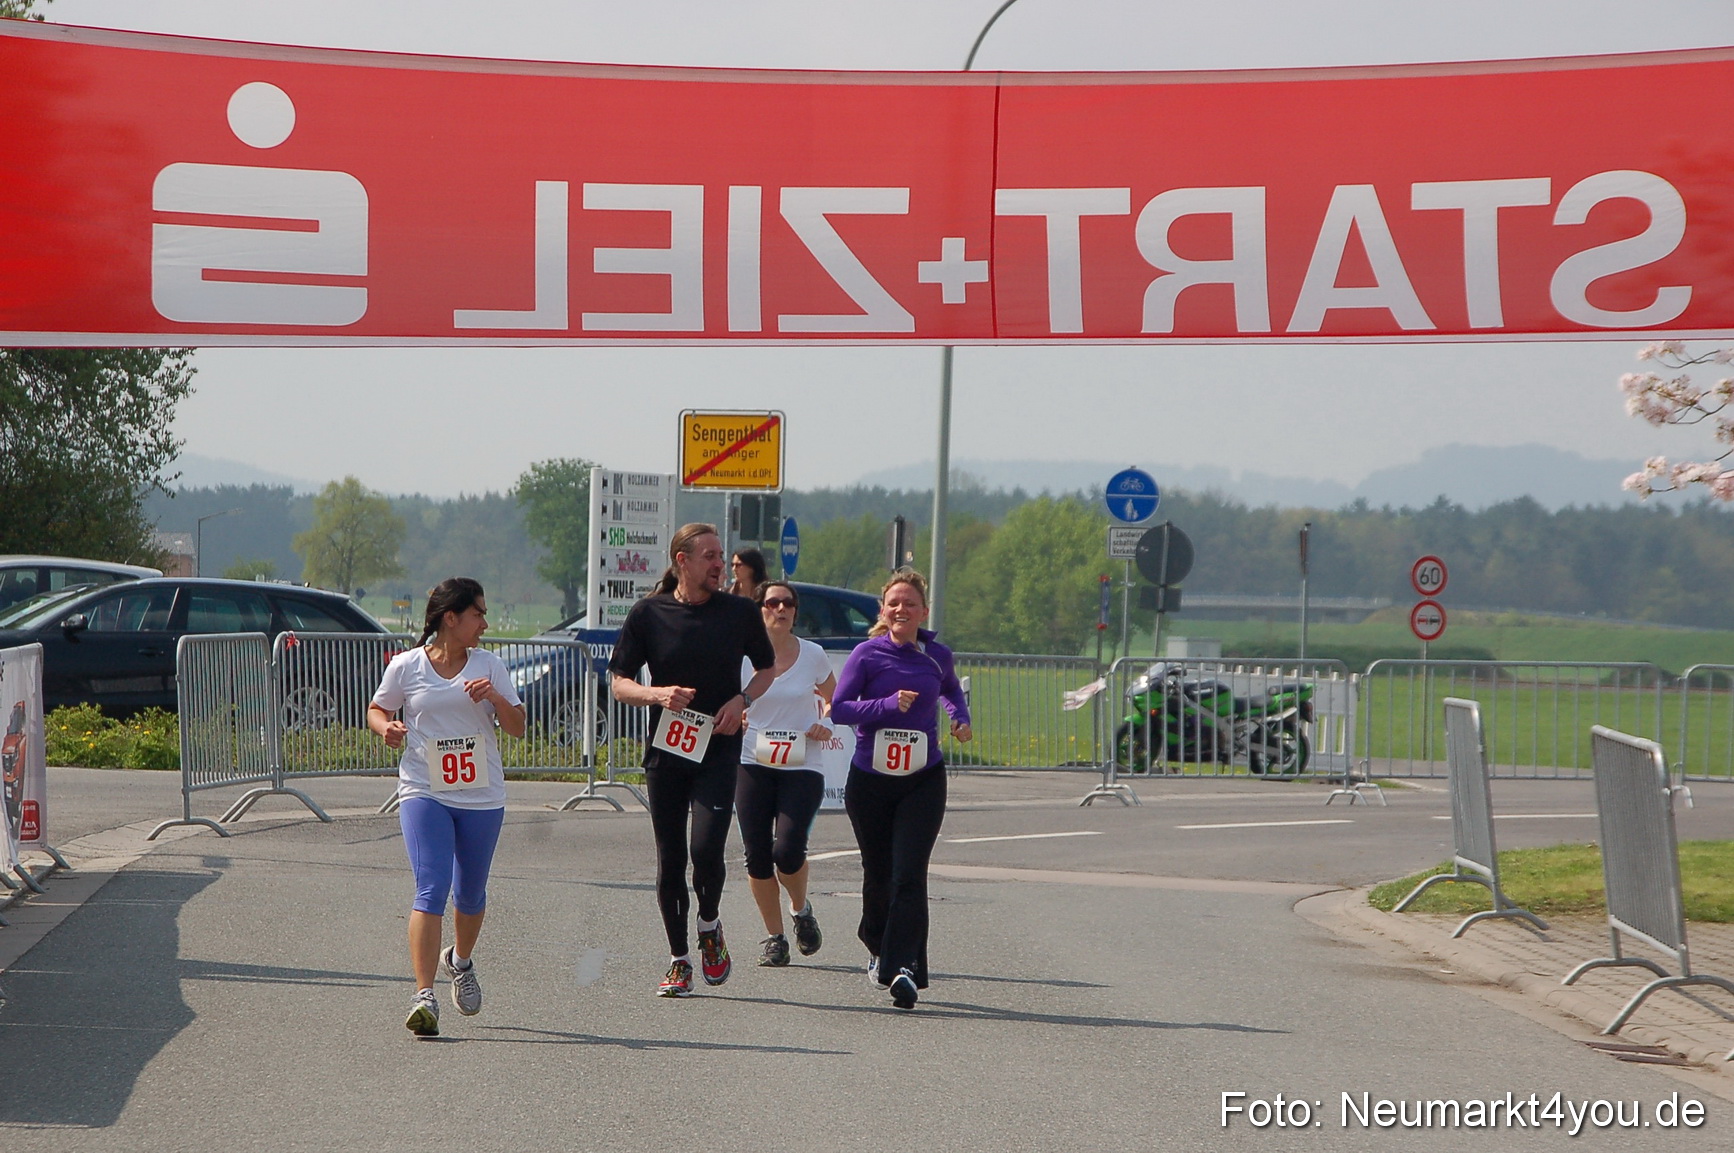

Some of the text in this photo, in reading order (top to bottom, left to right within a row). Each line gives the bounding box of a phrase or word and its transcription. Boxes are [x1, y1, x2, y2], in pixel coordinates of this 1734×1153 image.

[692, 423, 771, 446] Sengenthal
[702, 447, 760, 461] am Anger
[627, 473, 659, 487] HOLZAMMER
[710, 468, 745, 478] Neumarkt
[627, 500, 658, 512] HOLZAMMER
[609, 526, 626, 546] SHB
[1420, 567, 1440, 586] 60
[607, 579, 635, 599] THULE
[437, 738, 464, 747] MEYER
[665, 719, 699, 753] 85
[884, 730, 909, 739] MEYER
[769, 741, 792, 764] 77
[887, 742, 912, 771] 91
[442, 751, 476, 784] 95
